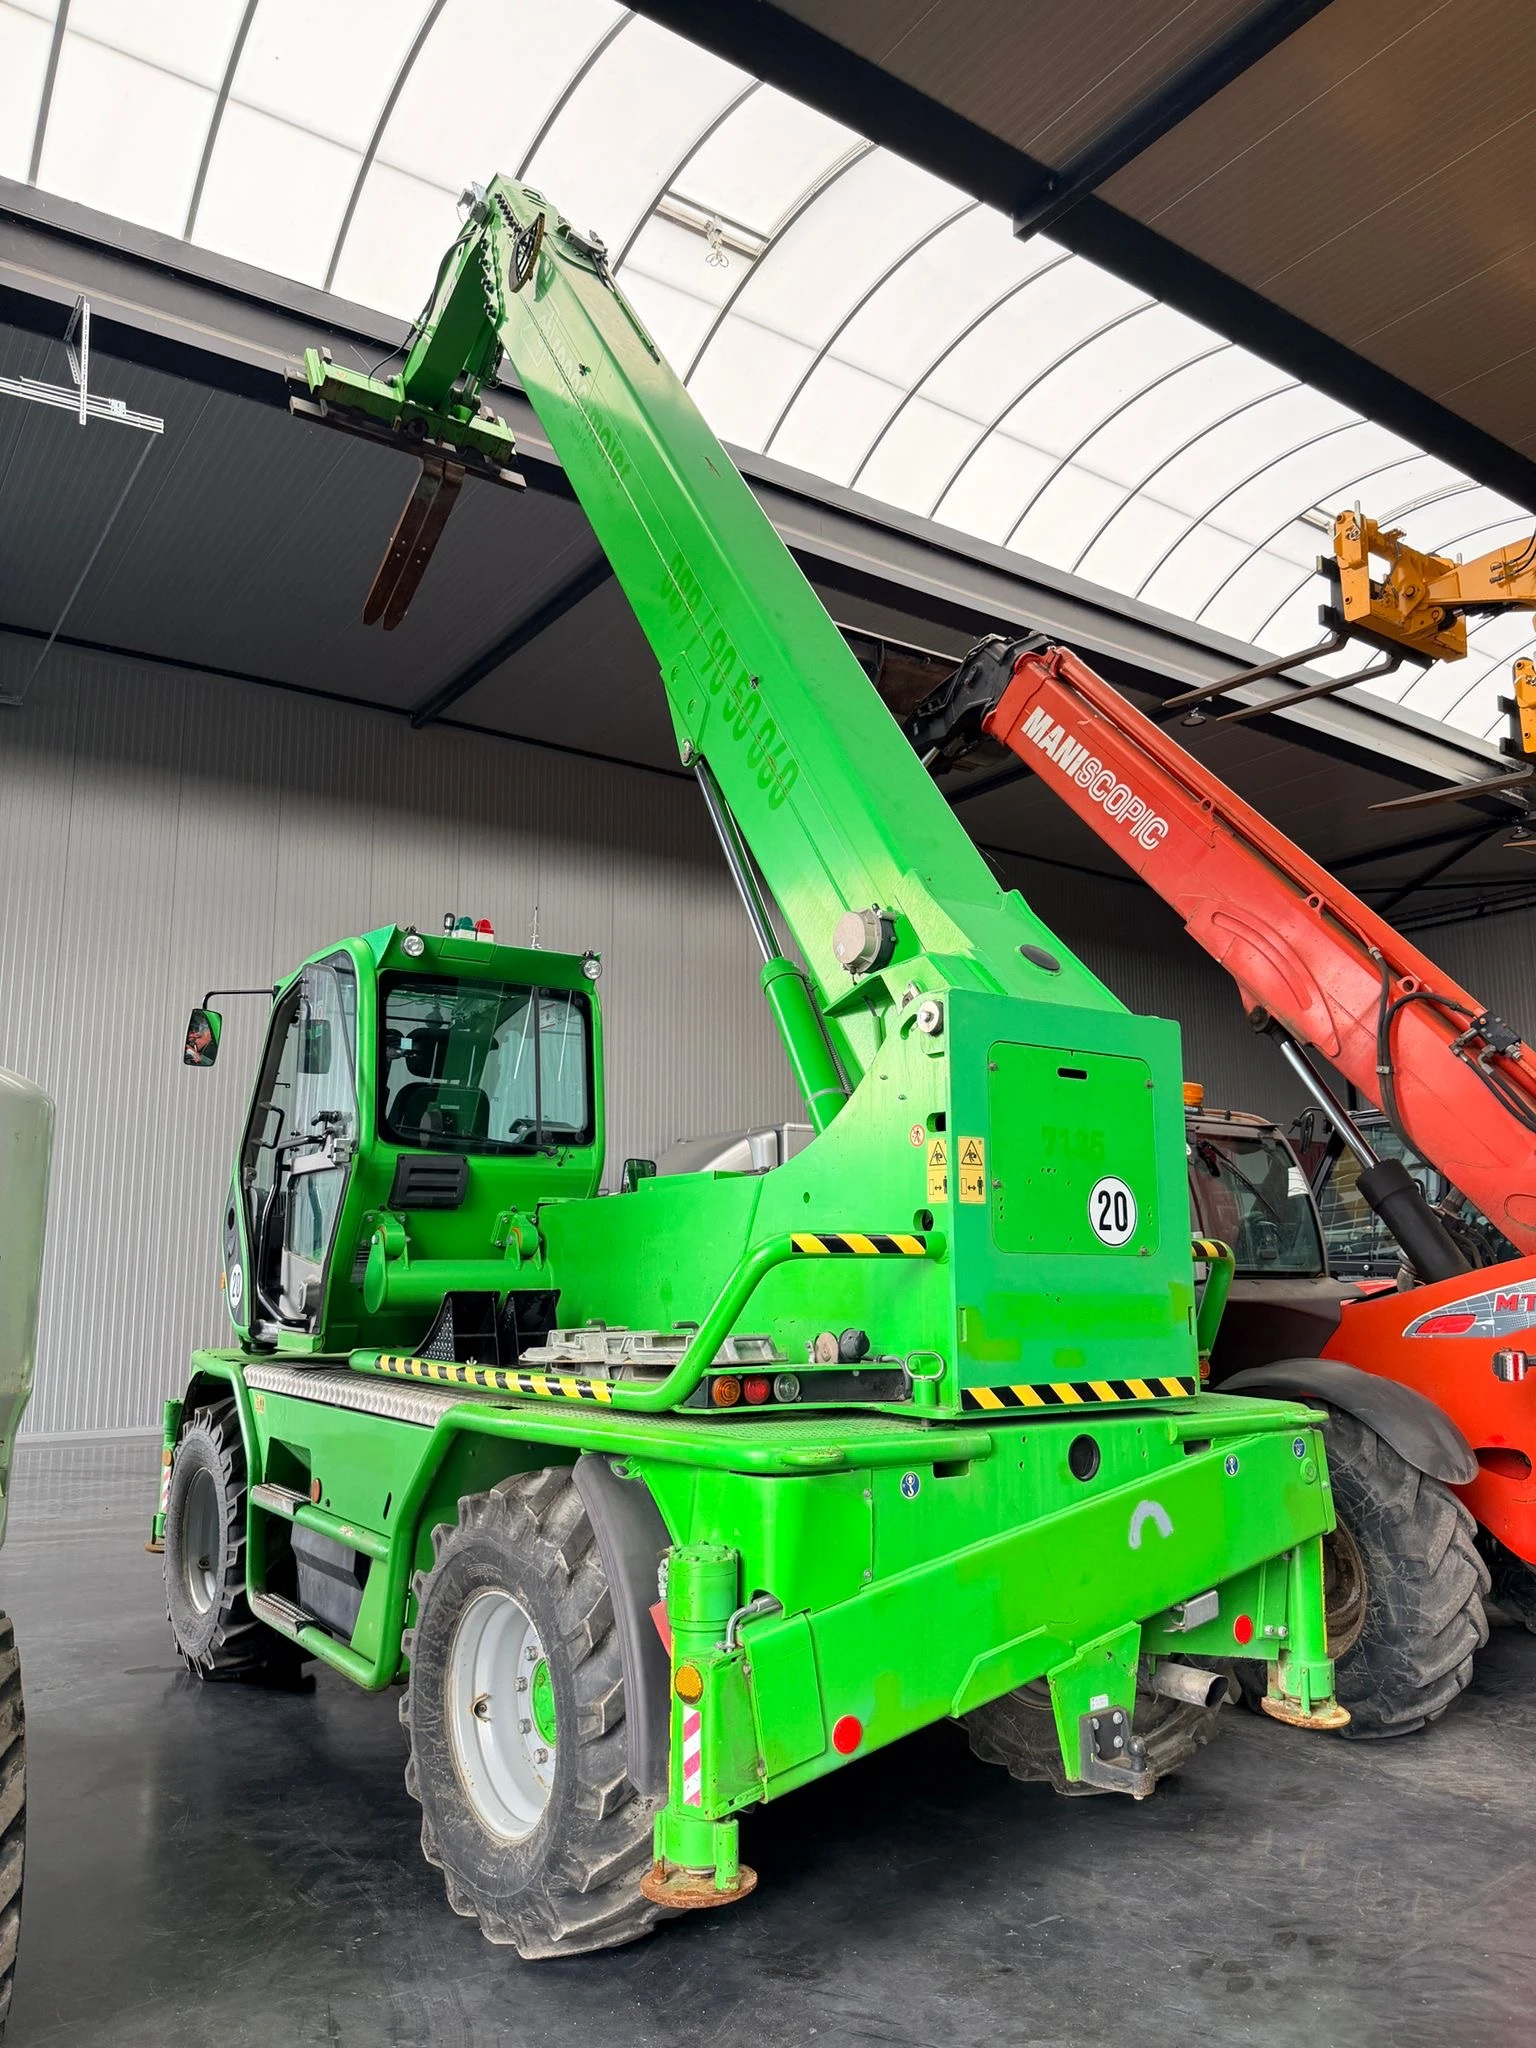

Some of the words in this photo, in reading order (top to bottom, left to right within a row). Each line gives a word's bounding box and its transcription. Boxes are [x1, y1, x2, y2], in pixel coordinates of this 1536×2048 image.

[1021, 705, 1169, 851] MANISCOPIC
[1098, 1189, 1129, 1232] 20
[231, 1271, 242, 1298] 20
